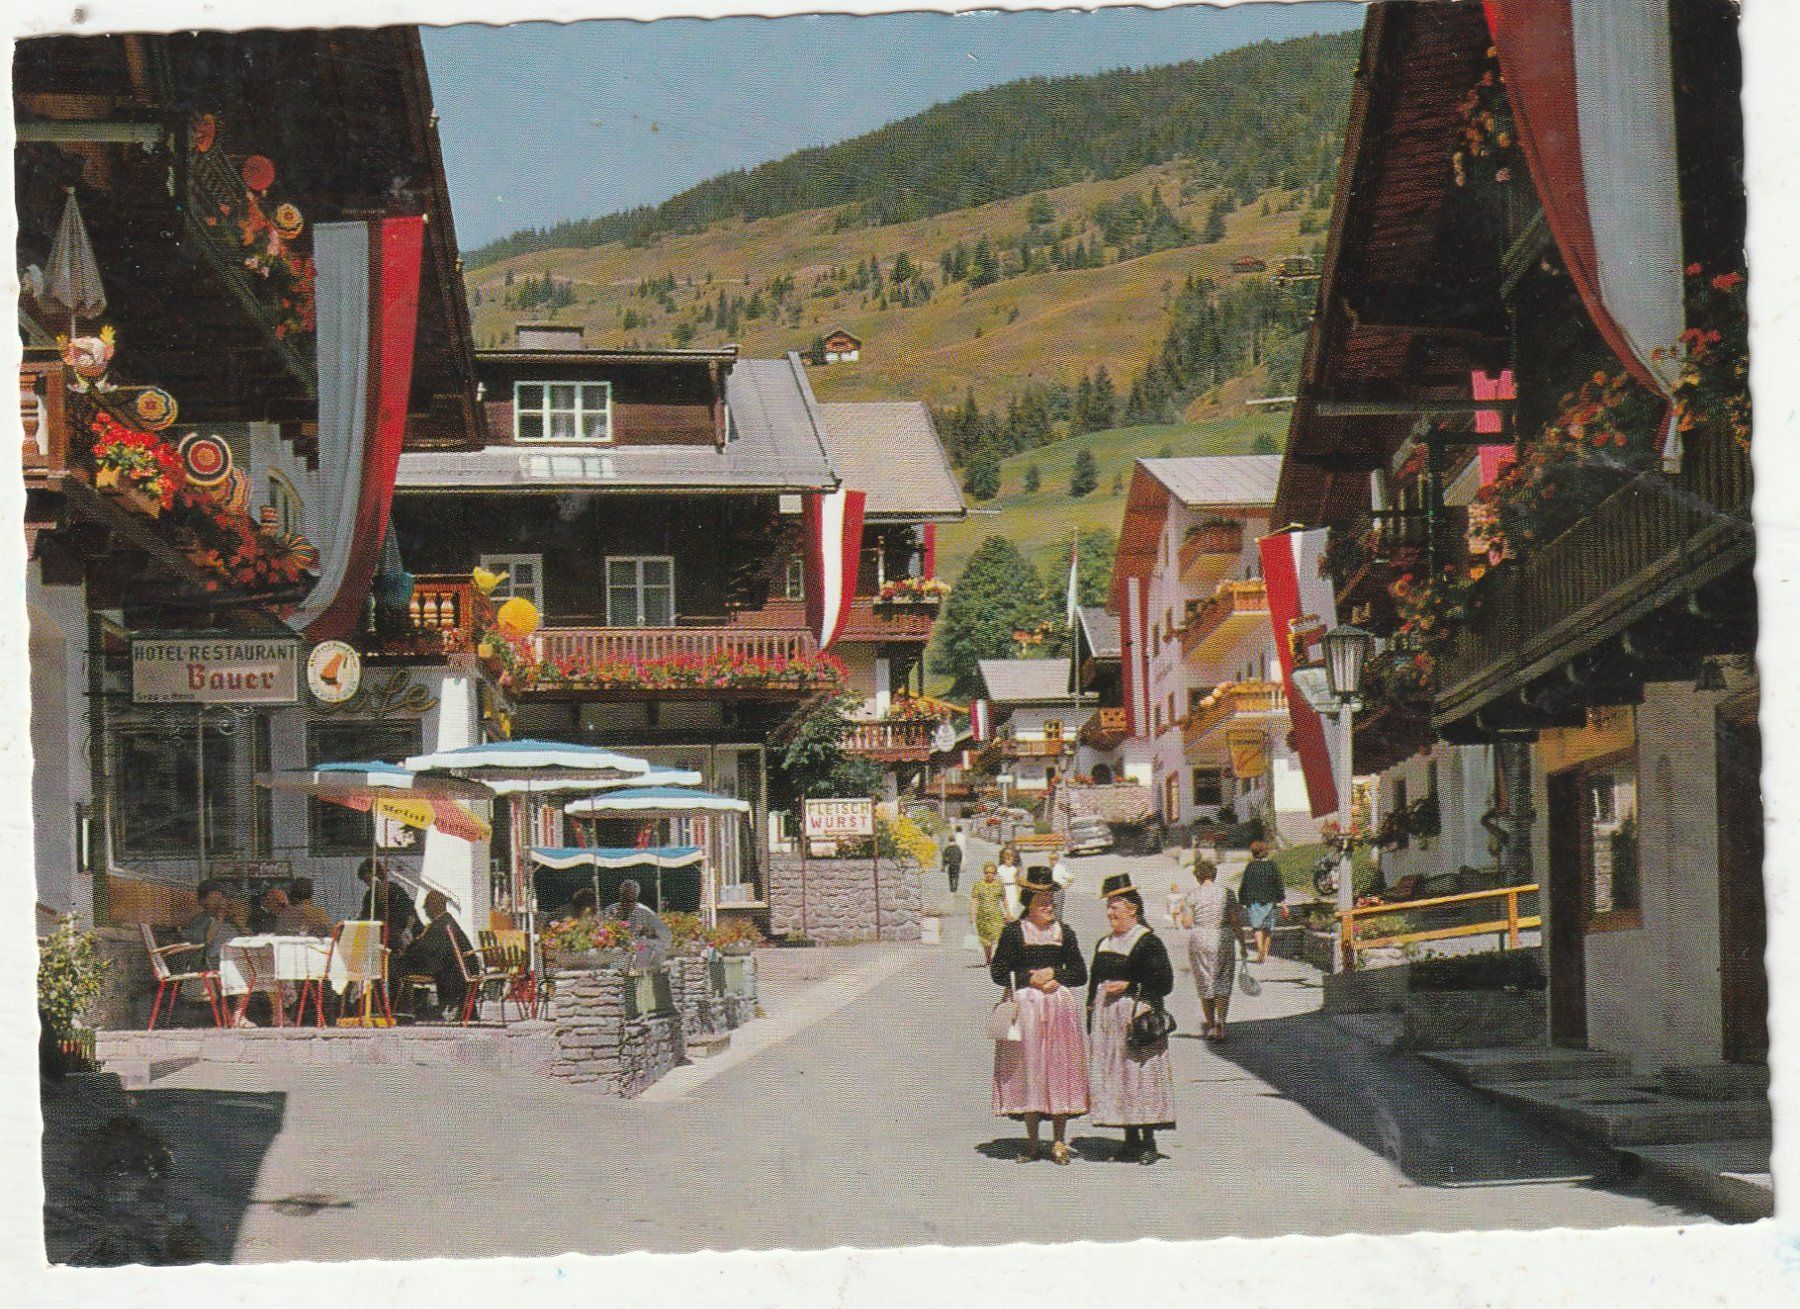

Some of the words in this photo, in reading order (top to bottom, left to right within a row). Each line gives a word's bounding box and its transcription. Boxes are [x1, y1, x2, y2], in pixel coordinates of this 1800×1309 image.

[187, 662, 275, 690] Bauer
[808, 801, 870, 815] FLEISCH
[810, 815, 868, 828] WURST
